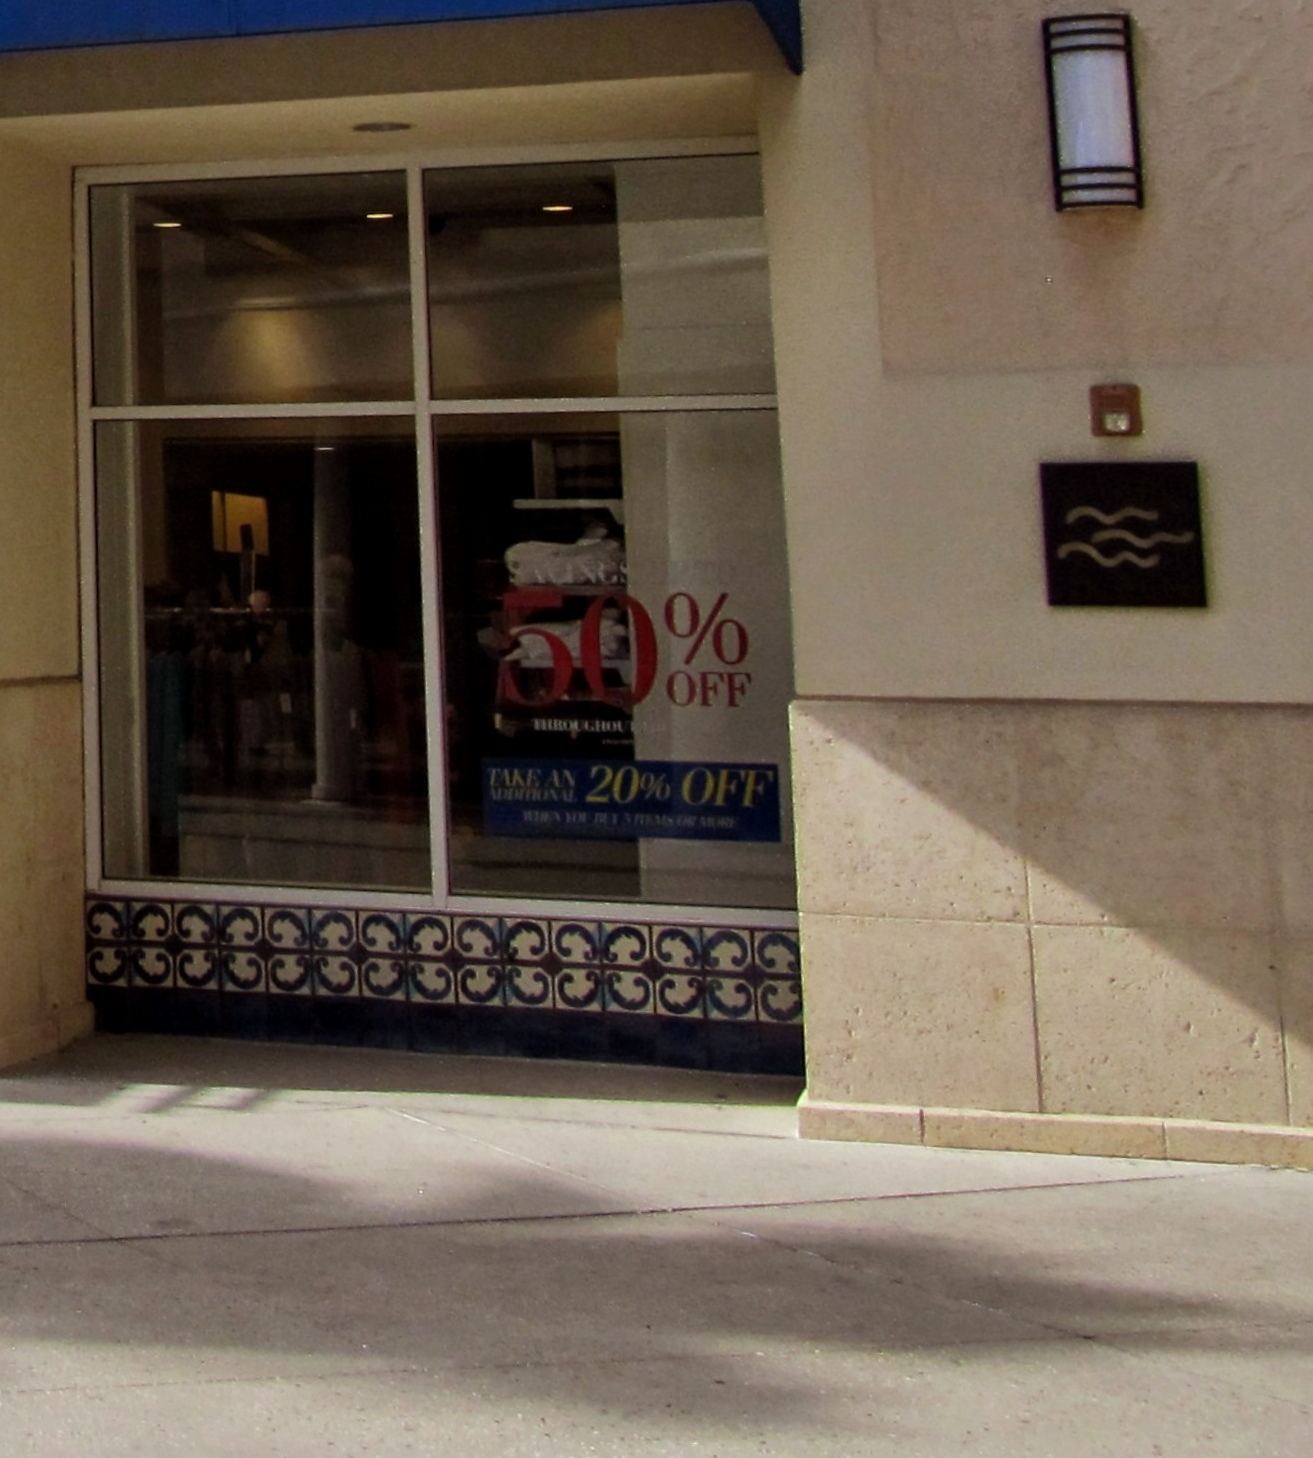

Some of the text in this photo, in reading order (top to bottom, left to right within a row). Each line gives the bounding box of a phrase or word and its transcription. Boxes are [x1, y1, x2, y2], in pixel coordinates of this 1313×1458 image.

[499, 589, 750, 708] 50%
[666, 671, 752, 707] OFF
[487, 767, 576, 788] TAKE AN
[585, 764, 774, 809] 20% OFF
